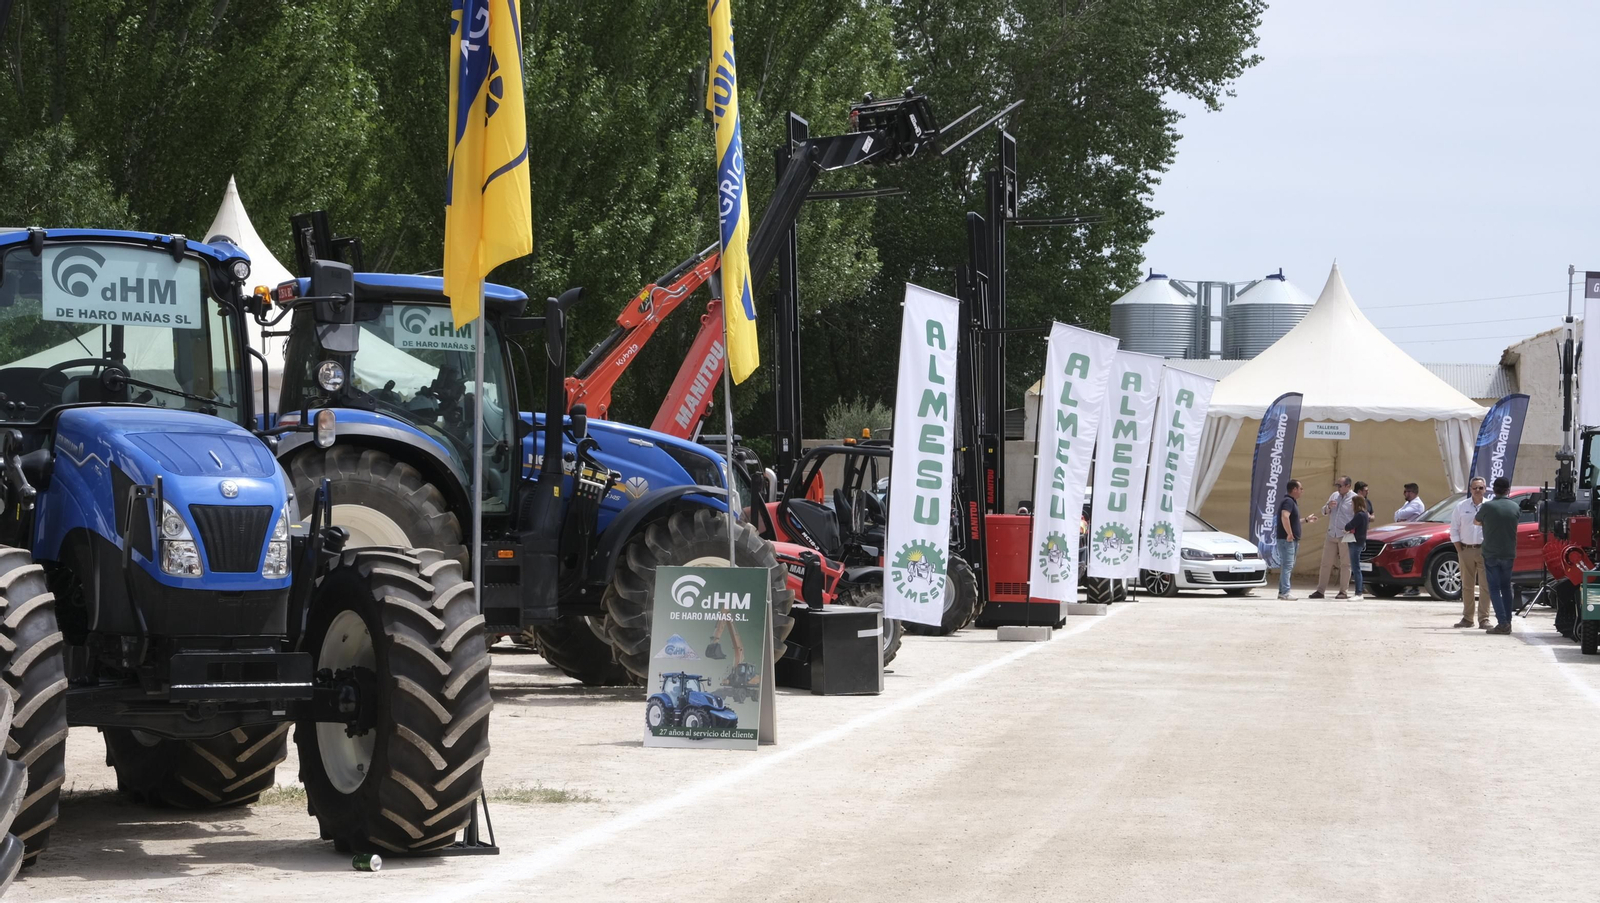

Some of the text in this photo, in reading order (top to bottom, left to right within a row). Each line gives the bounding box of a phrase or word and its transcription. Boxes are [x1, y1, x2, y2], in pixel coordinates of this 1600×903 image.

[101, 277, 176, 305] dHM
[56, 308, 191, 324] DE HARO MAÑAS SL
[441, 342, 468, 350] MAÑAS
[616, 344, 638, 366] Kubota
[675, 340, 724, 430] MANITOU
[913, 319, 948, 526] ALMESU
[1108, 372, 1142, 512] ALMESU
[1160, 389, 1194, 513] ALMESU
[970, 501, 979, 540] MANITOU
[701, 592, 751, 610] dHM
[670, 611, 749, 622] DE HARO MAÑAS, S.L.
